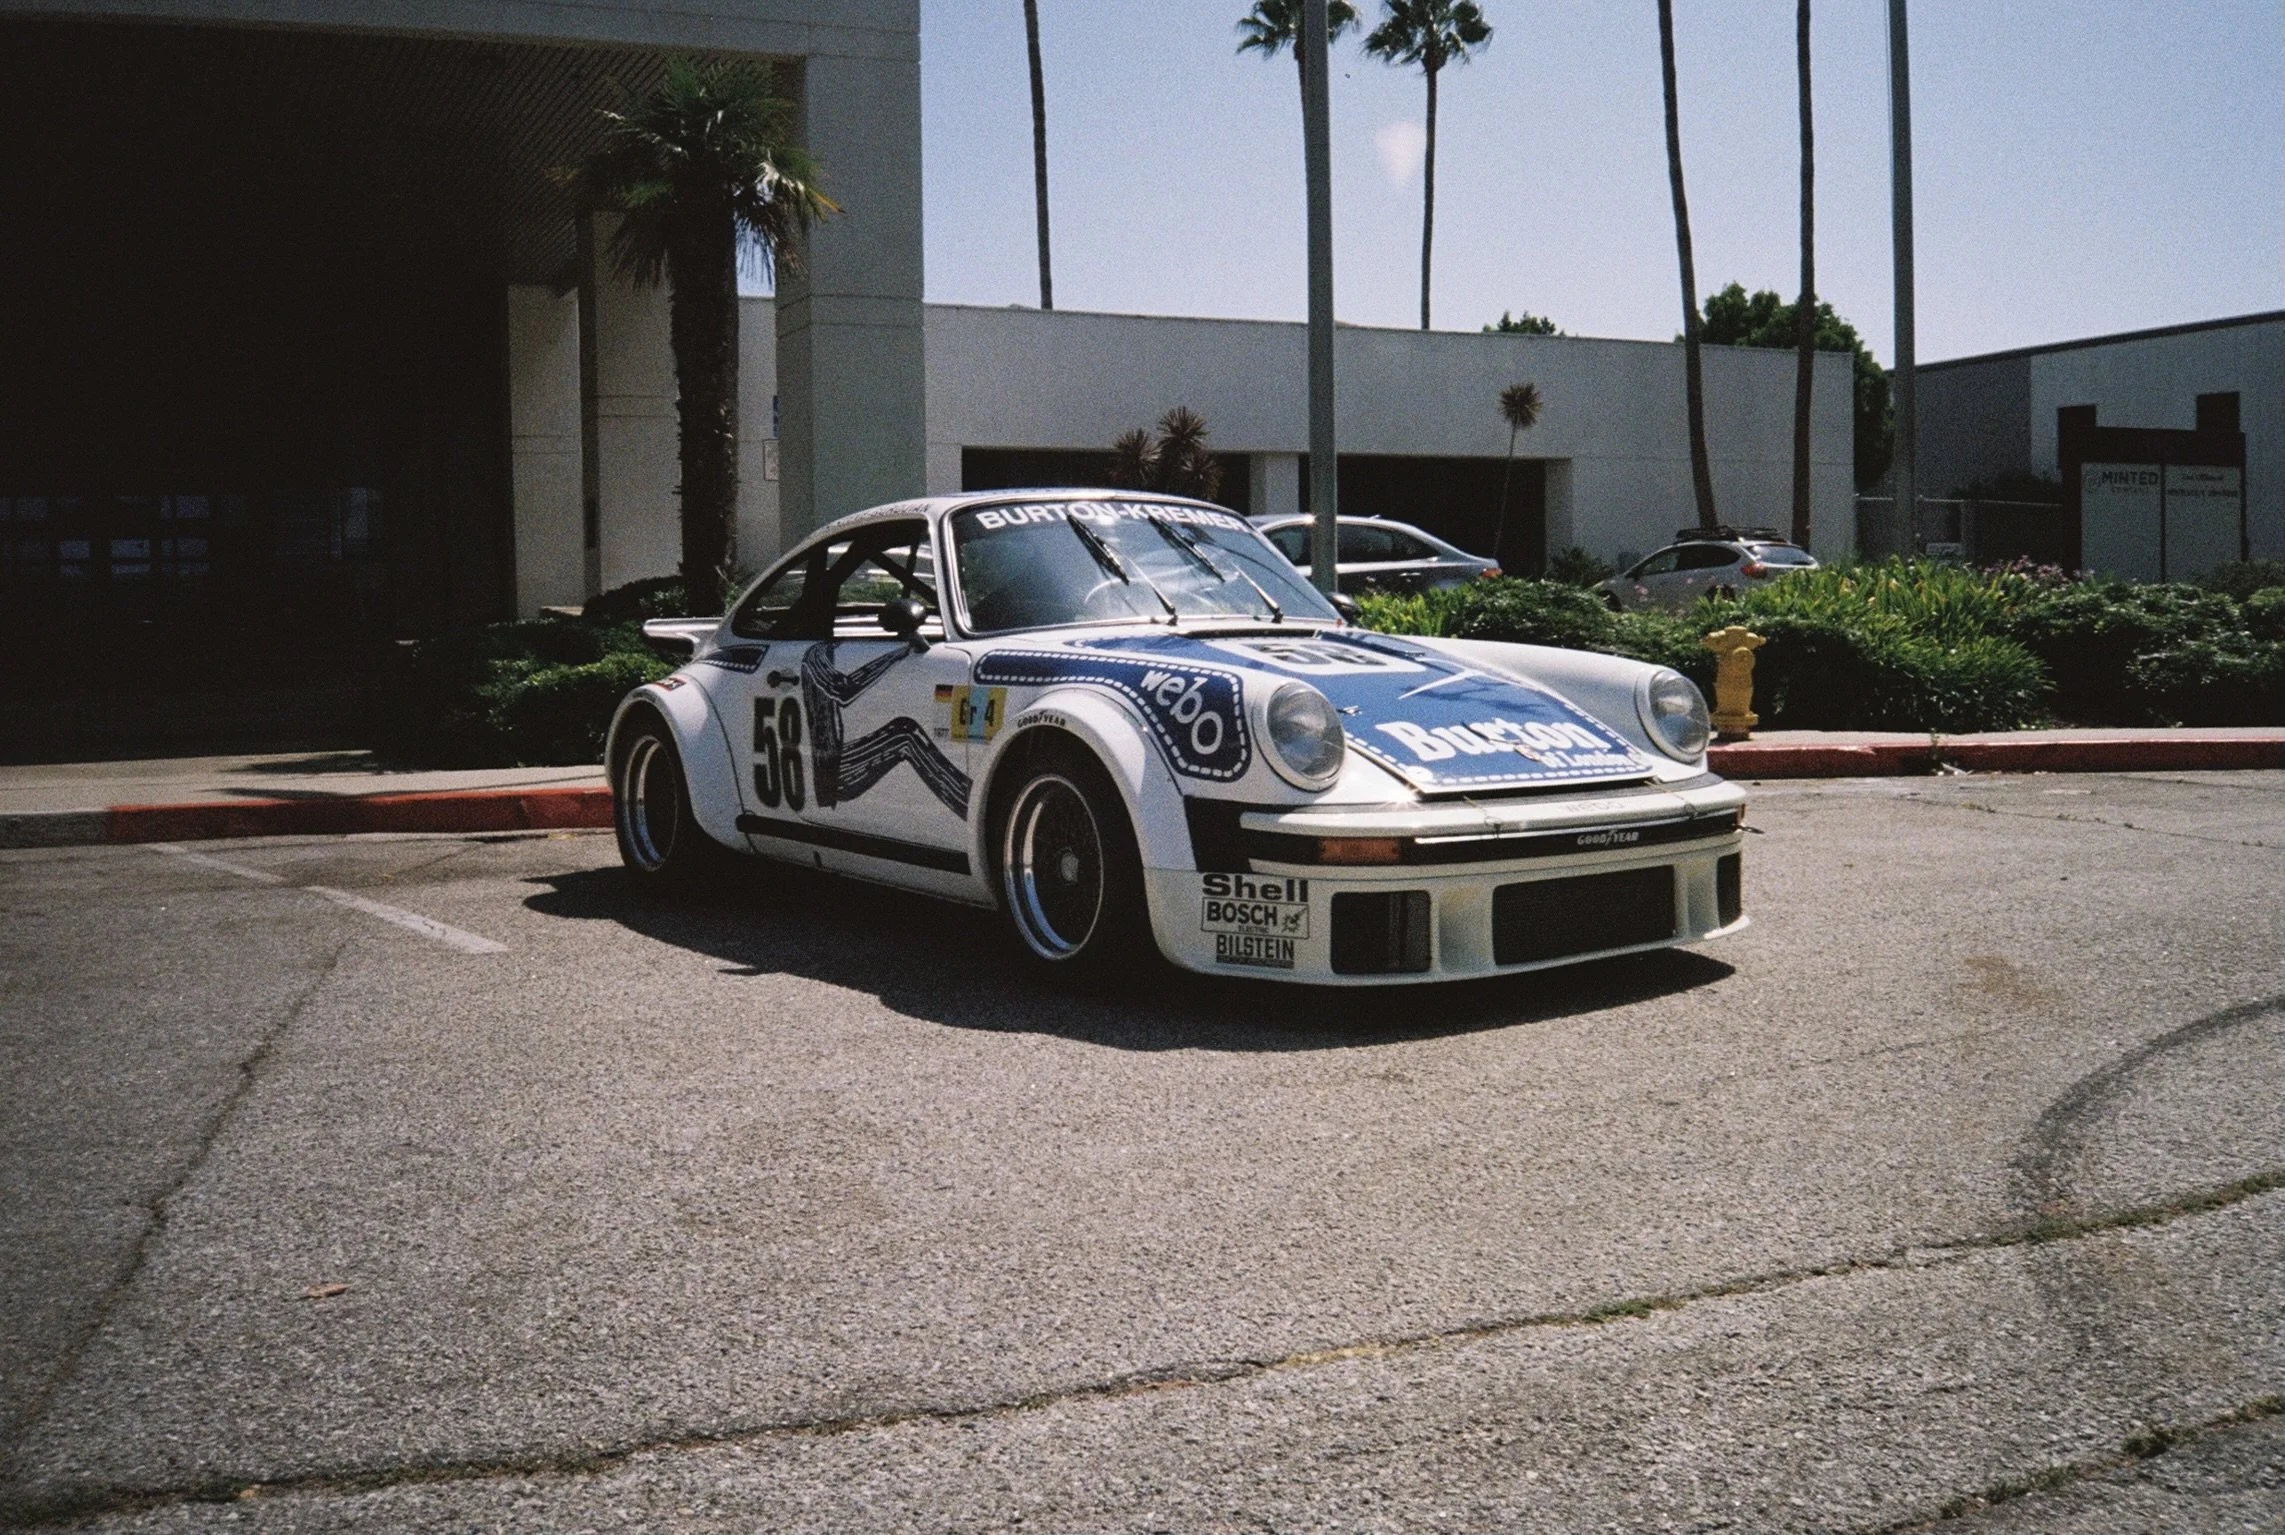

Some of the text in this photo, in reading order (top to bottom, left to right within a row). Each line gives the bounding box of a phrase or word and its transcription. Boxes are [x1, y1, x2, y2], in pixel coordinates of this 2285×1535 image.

[2101, 471, 2159, 485] MINTED
[984, 698, 997, 727] 4
[1140, 669, 1224, 756] webo
[753, 697, 805, 812] 58
[1577, 830, 1639, 846] GOODYEAR
[1202, 873, 1309, 902] Shell
[1206, 901, 1278, 927] BOSCH
[1216, 934, 1295, 961] BILSTEIN
